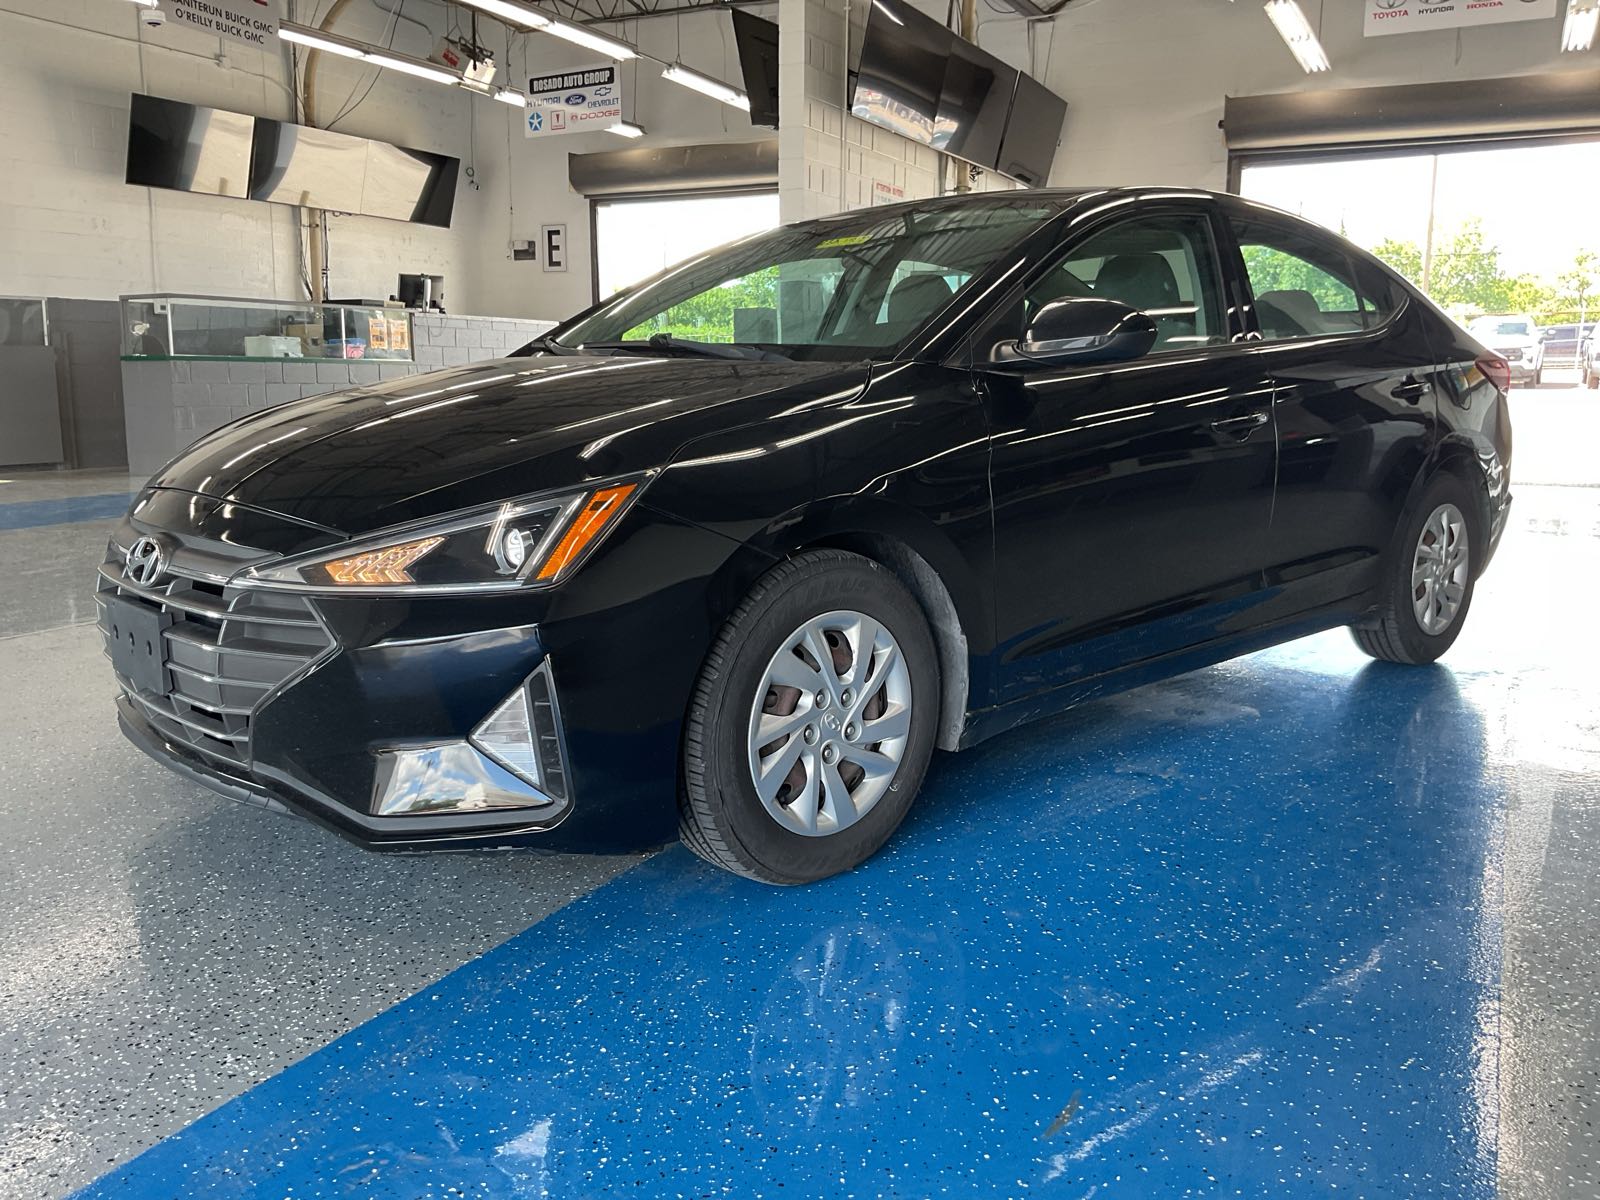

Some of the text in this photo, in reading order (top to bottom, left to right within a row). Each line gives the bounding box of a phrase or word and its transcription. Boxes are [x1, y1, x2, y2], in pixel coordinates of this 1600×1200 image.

[1418, 5, 1455, 15] HYUNDAI
[1466, 0, 1504, 10] HONDA
[1372, 9, 1409, 20] TOYOTA
[175, 8, 264, 44] O'REILLY BUICK GMC
[225, 10, 251, 27] BUICK
[253, 20, 273, 34] GMC
[533, 70, 610, 92] ROSADO AUTO GROUP
[526, 96, 561, 108] HYUNDAI
[567, 95, 586, 105] Ford
[587, 97, 620, 109] CHEVROLET
[580, 109, 620, 121] DODGE
[547, 229, 562, 267] E
